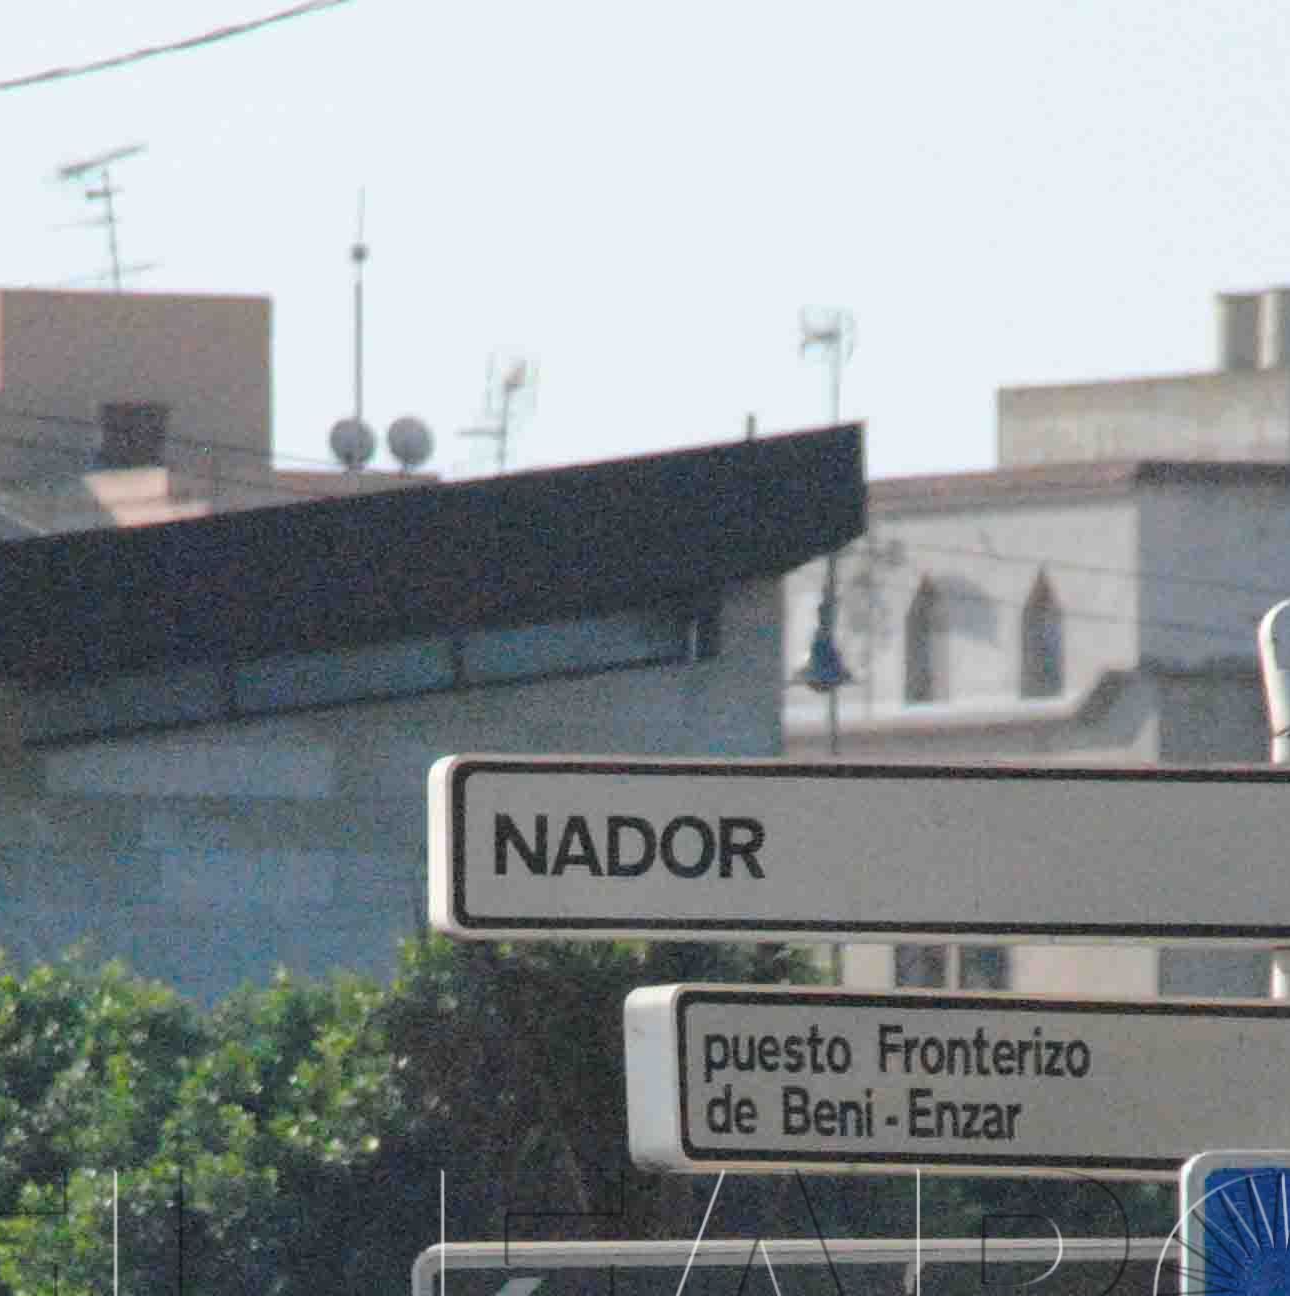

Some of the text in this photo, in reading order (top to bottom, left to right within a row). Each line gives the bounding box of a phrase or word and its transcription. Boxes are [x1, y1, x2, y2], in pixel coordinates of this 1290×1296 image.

[494, 812, 766, 879] NADOR
[703, 1023, 1092, 1084] puesto Fronterizo
[705, 1083, 758, 1135] de
